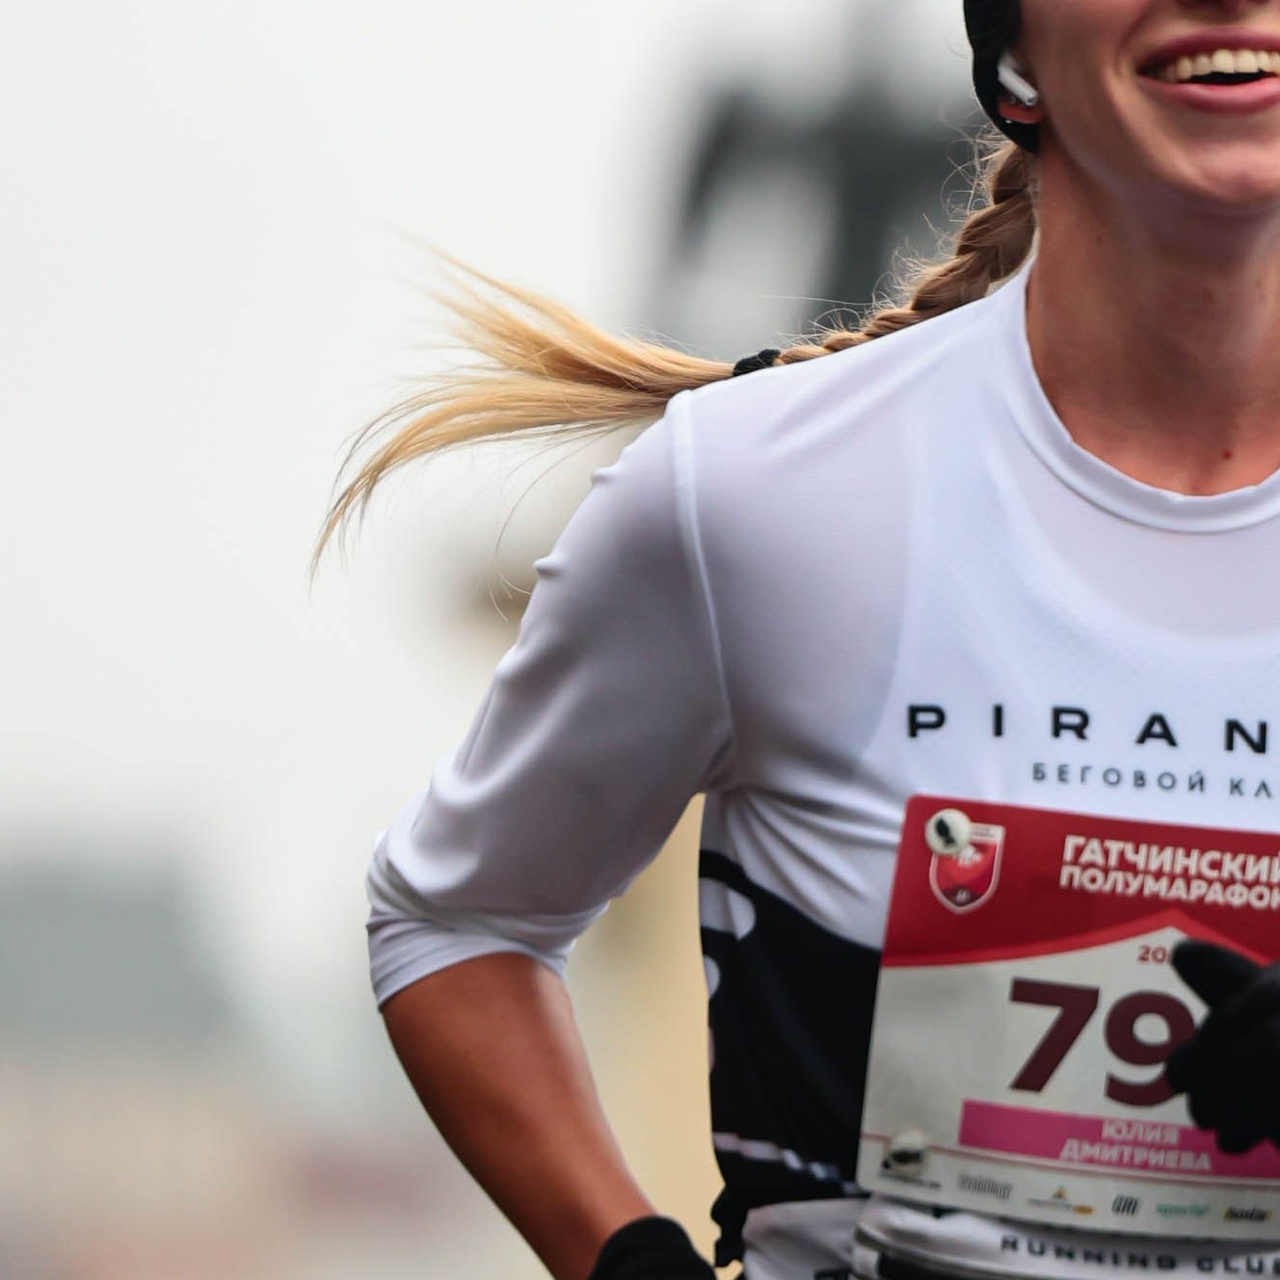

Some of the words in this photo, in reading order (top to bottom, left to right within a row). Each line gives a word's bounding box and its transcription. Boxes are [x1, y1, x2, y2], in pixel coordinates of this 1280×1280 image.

[1032, 761, 1206, 794] БЕГОВОЙ
[1136, 944, 1172, 964] 20
[1008, 975, 1197, 1108] 79
[1101, 1119, 1180, 1145] ЮЛИЯ
[1058, 1137, 1213, 1171] ДМИТРИЕВА
[1001, 1234, 1178, 1271] RUNNING
